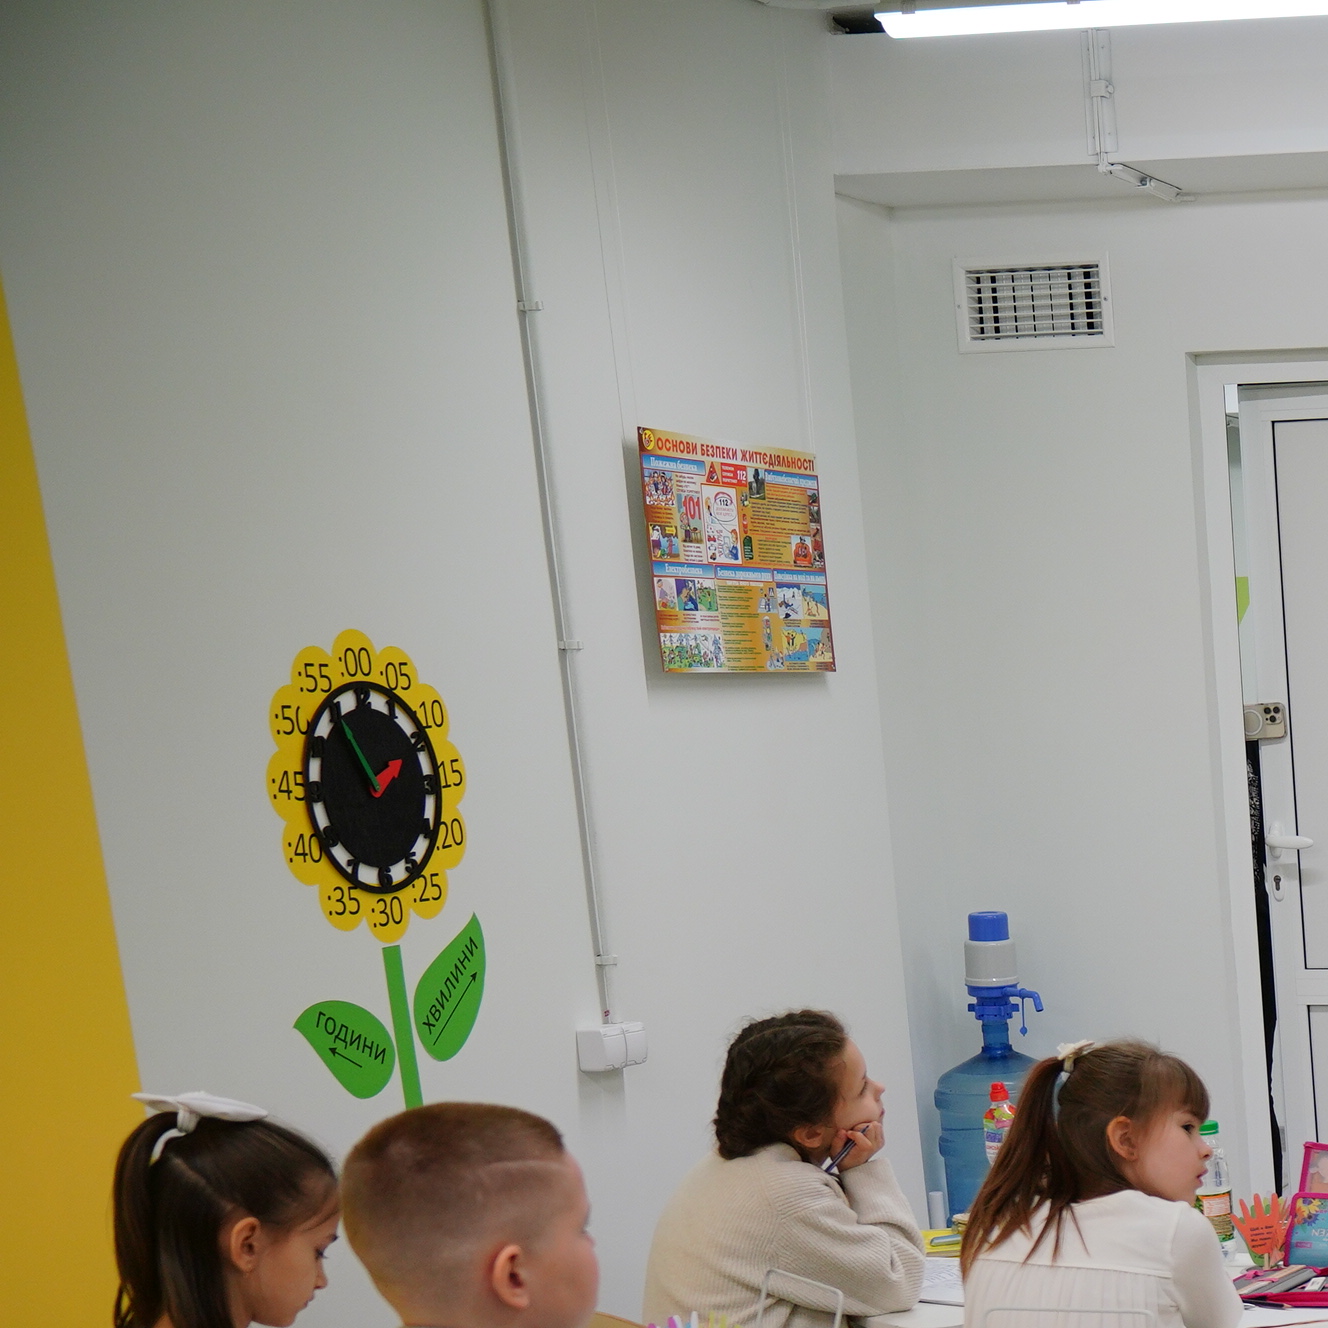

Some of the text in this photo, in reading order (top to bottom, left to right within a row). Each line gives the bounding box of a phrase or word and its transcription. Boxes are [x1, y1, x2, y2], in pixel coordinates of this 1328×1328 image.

[656, 437, 815, 472] ОСНОВИ БЕЗПЕКИ ЖИТТЄДІЯЛЬНОСТІ
[737, 470, 747, 481] 112
[683, 495, 702, 520] 101
[719, 499, 729, 507] 112
[338, 647, 371, 677] :00
[298, 663, 332, 693] :55
[371, 895, 404, 928] :30
[422, 936, 478, 1035] ХВИЛИНИ
[315, 1011, 387, 1065] ГОДИНИ
